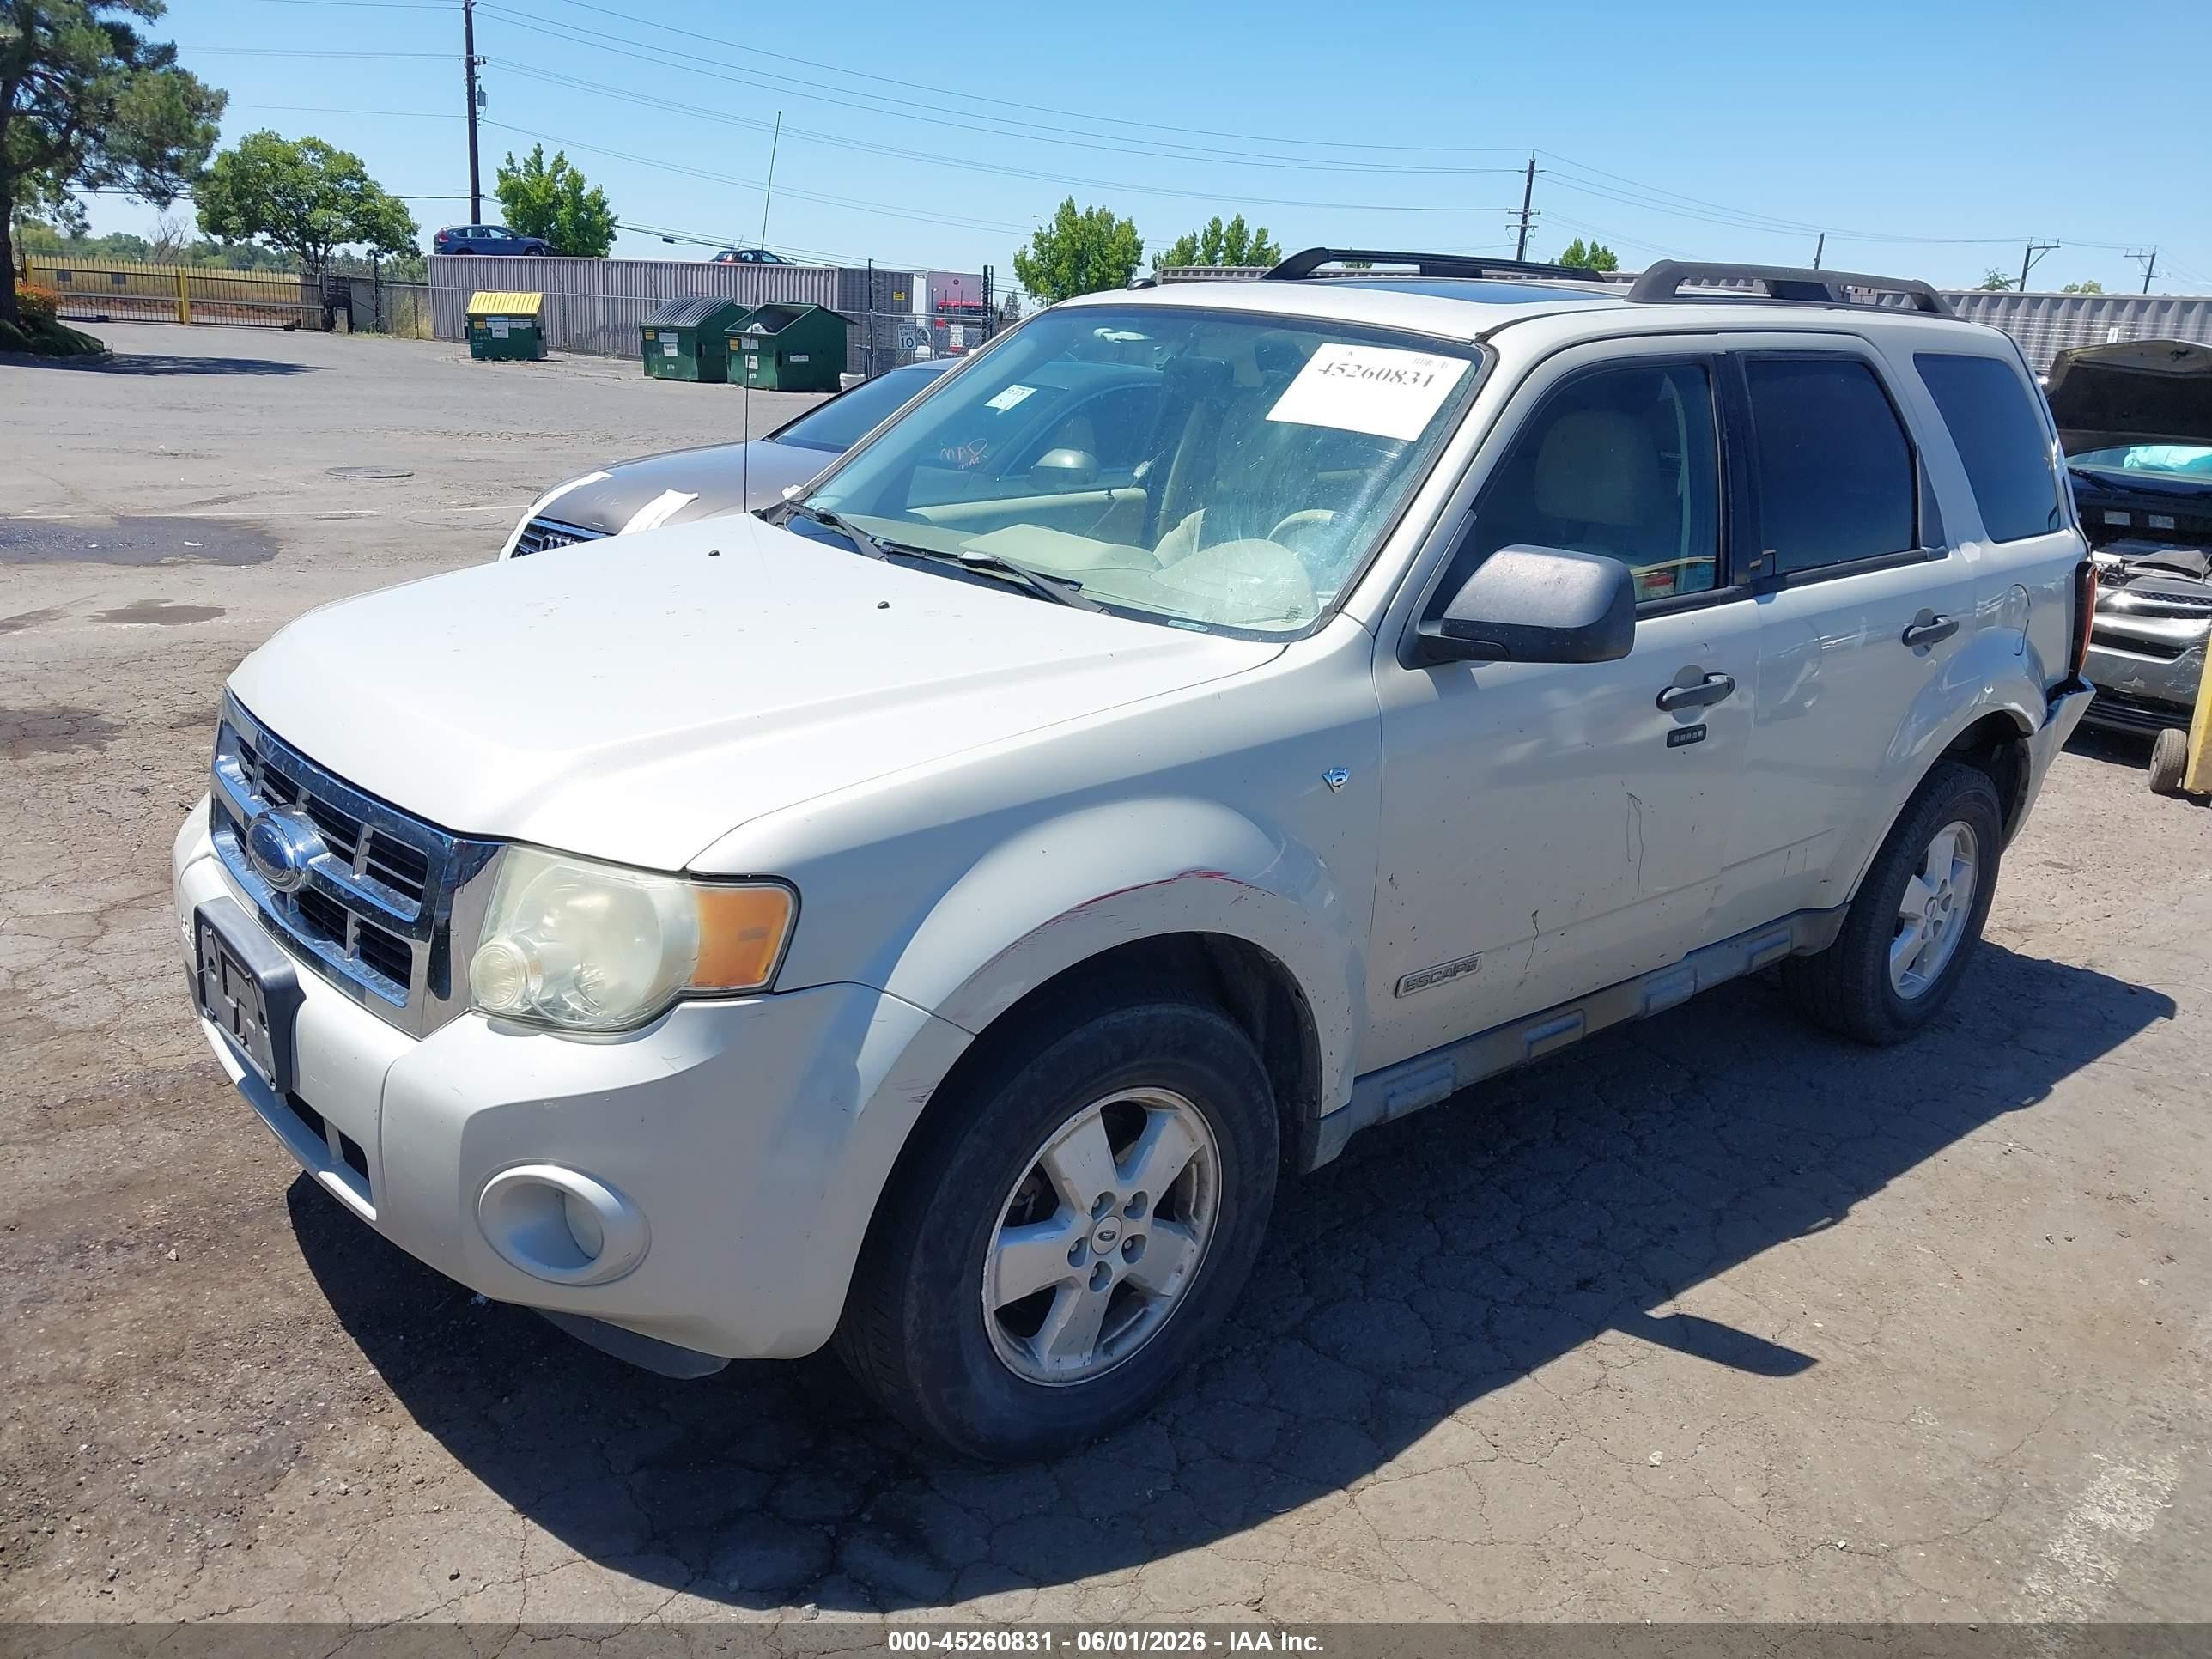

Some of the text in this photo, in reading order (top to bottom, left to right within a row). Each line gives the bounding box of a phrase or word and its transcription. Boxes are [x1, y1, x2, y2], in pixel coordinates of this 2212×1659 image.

[902, 337, 914, 348] 10
[1318, 362, 1435, 387] 45260831
[1405, 958, 1479, 993] ESCAPE
